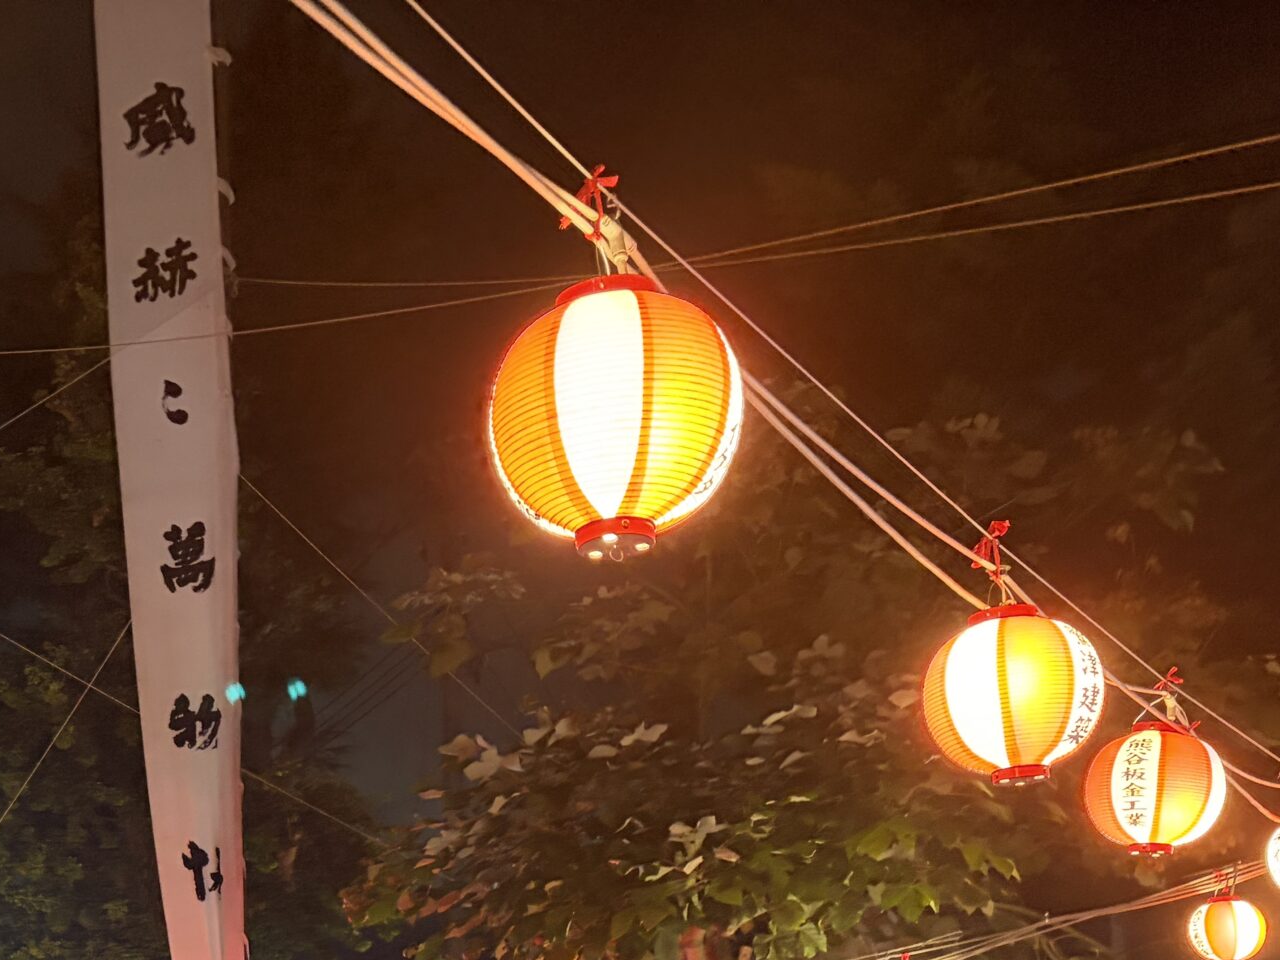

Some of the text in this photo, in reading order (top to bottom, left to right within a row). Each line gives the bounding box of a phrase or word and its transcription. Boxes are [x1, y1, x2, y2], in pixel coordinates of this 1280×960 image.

[1122, 737, 1153, 827] 熊谷板金工業
